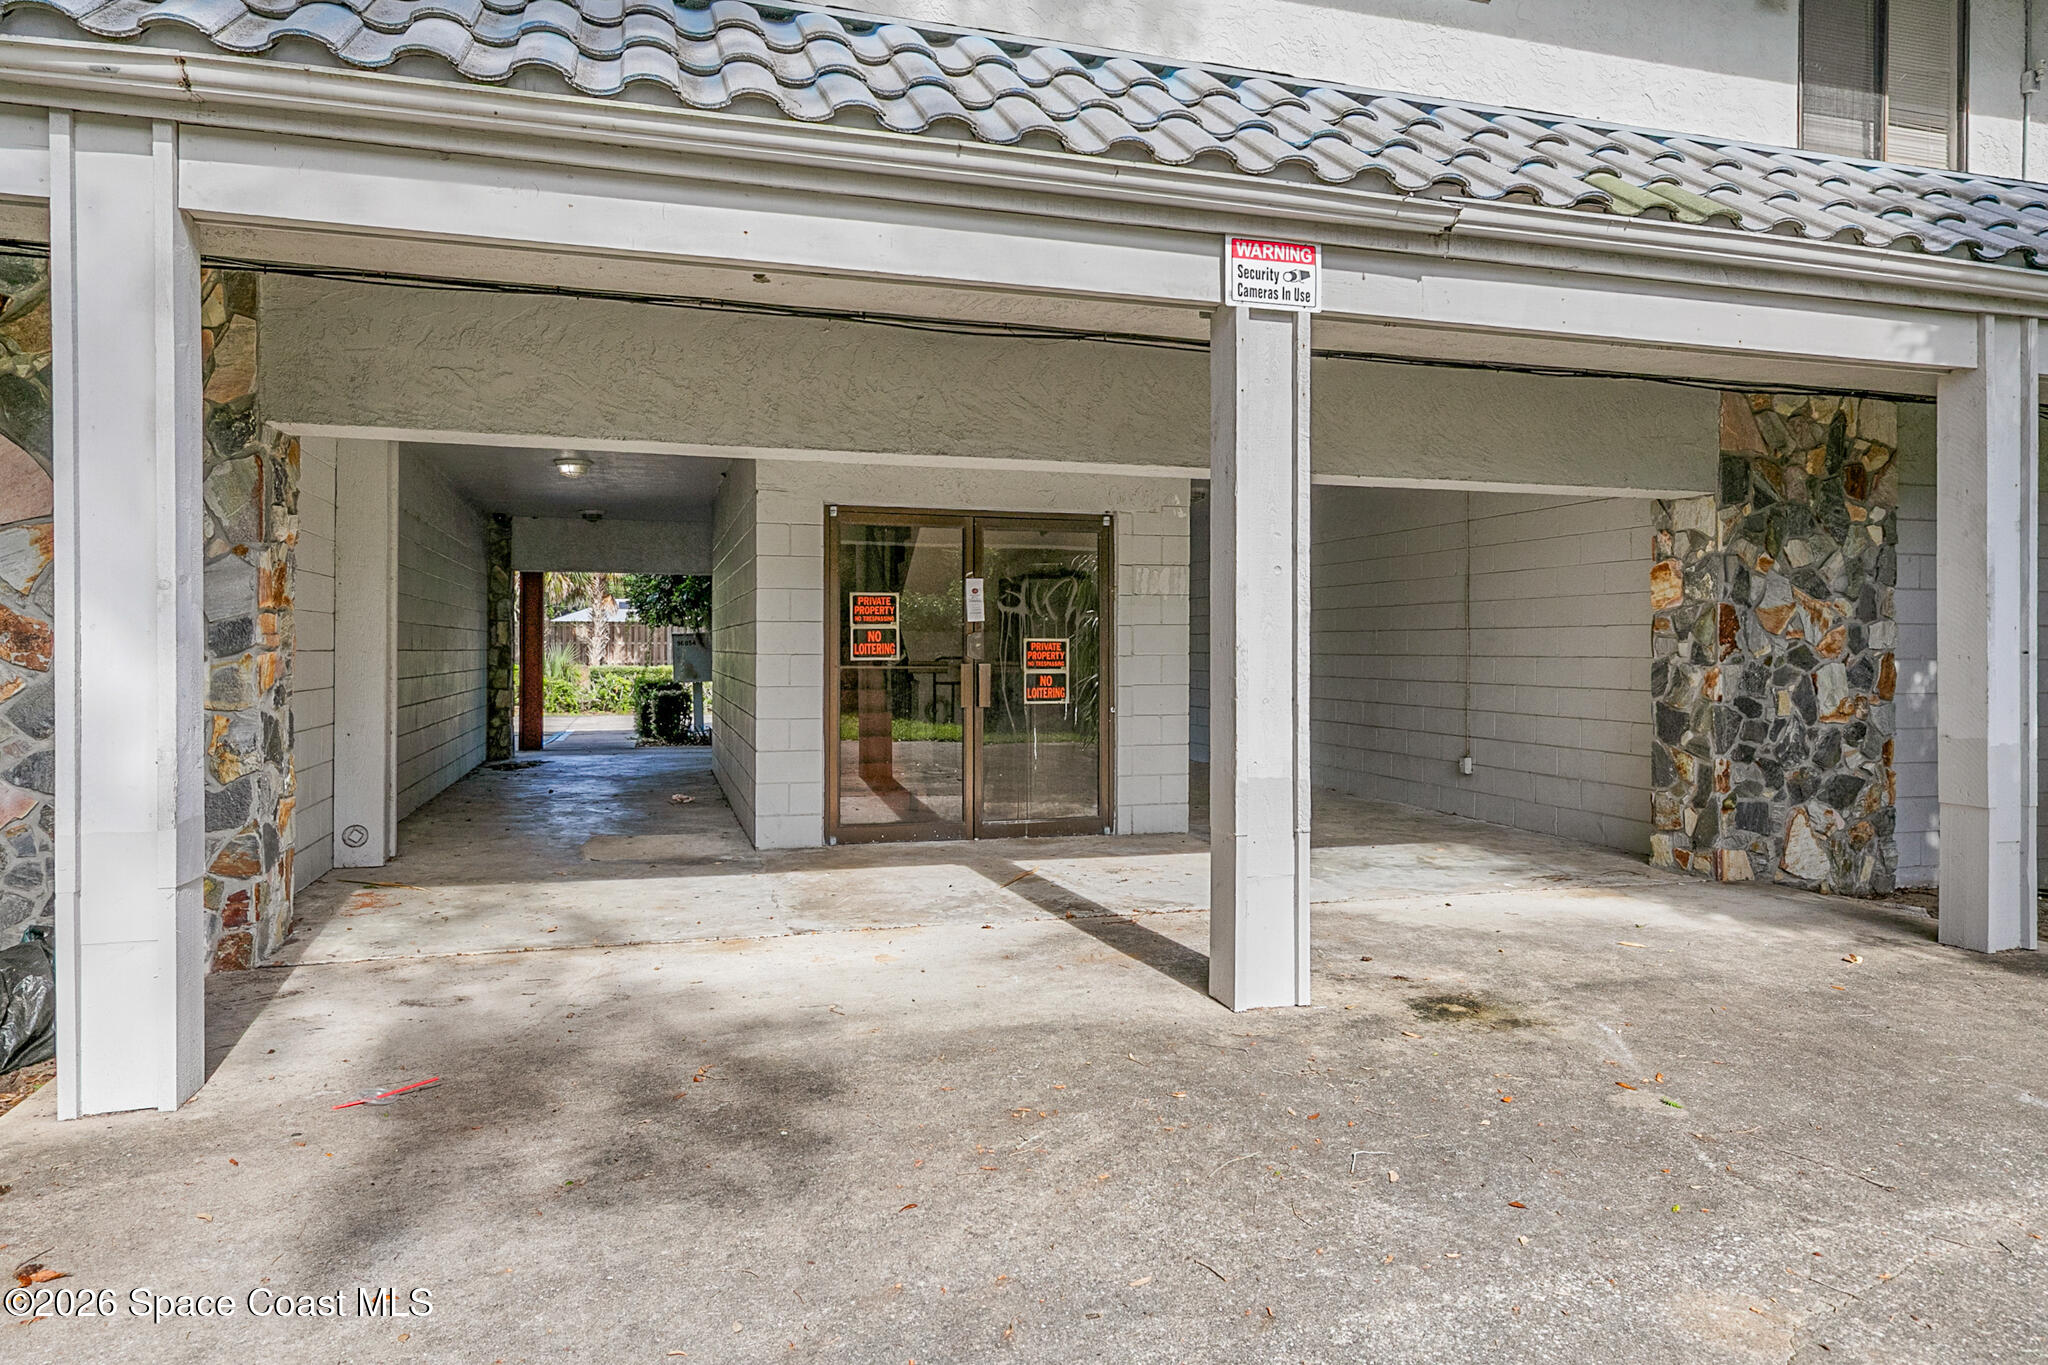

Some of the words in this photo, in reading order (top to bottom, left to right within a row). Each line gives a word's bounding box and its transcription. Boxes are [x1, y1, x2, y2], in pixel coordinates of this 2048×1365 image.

[1236, 241, 1312, 263] WARNING
[1237, 264, 1280, 284] Security
[1237, 282, 1279, 300] Cameras
[1282, 286, 1291, 301] In
[1294, 287, 1311, 303] Use
[857, 596, 891, 605] PRIVATE
[854, 605, 894, 615] PROPERTY
[867, 630, 882, 642] NO
[853, 642, 895, 655] LOITERING
[1030, 642, 1061, 651] PRIVATE
[1027, 651, 1064, 660] PROPERTY
[1039, 675, 1053, 687] NO
[1026, 686, 1065, 699] LOITERING
